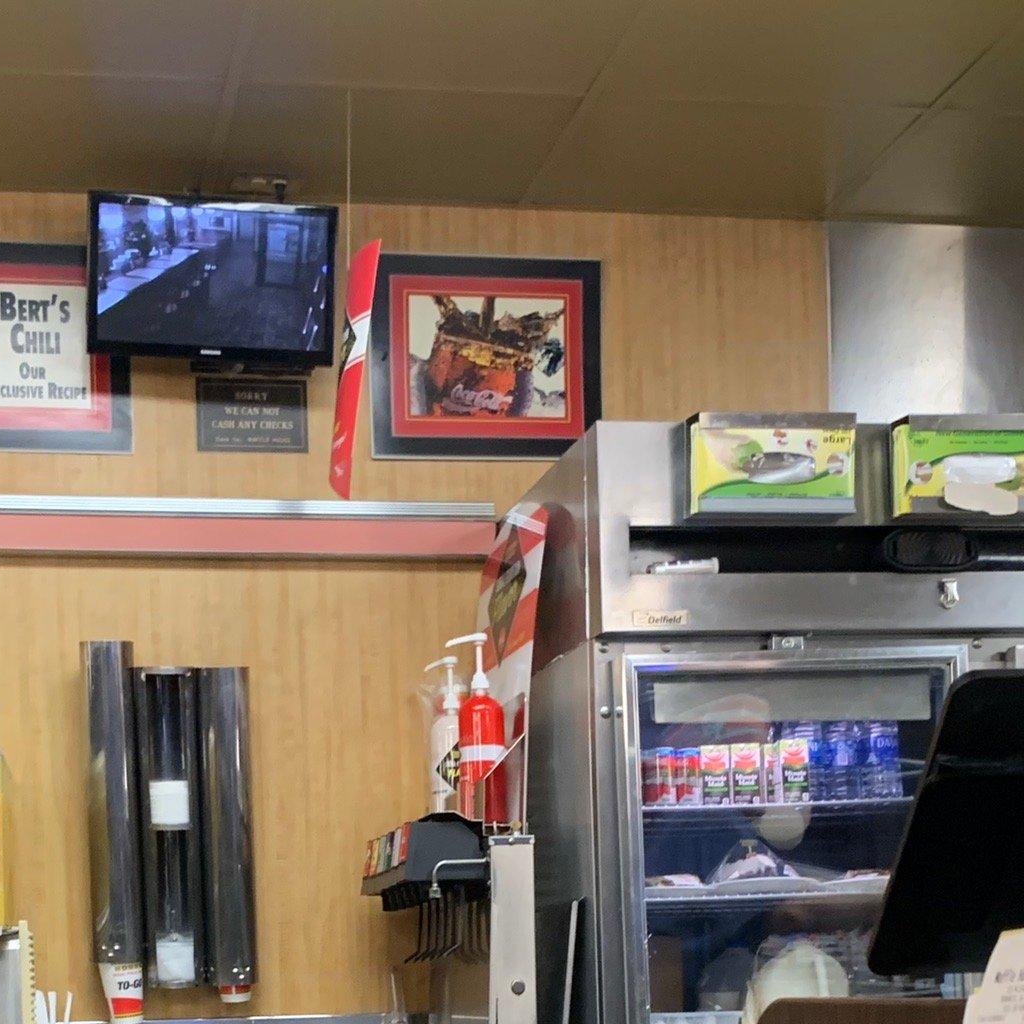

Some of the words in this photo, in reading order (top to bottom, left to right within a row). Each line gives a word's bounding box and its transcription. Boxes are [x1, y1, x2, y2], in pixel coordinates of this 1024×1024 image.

[0, 291, 71, 323] BERT'S
[10, 323, 61, 354] CHILI
[19, 362, 46, 380] OUR
[47, 382, 87, 400] RECIPE
[224, 407, 238, 415] WE
[241, 407, 260, 415] CAN
[263, 407, 280, 416] NOT
[211, 420, 235, 429] CASH
[237, 420, 257, 429] ANY
[259, 421, 294, 430] CHECKS
[647, 615, 682, 624] Delfield
